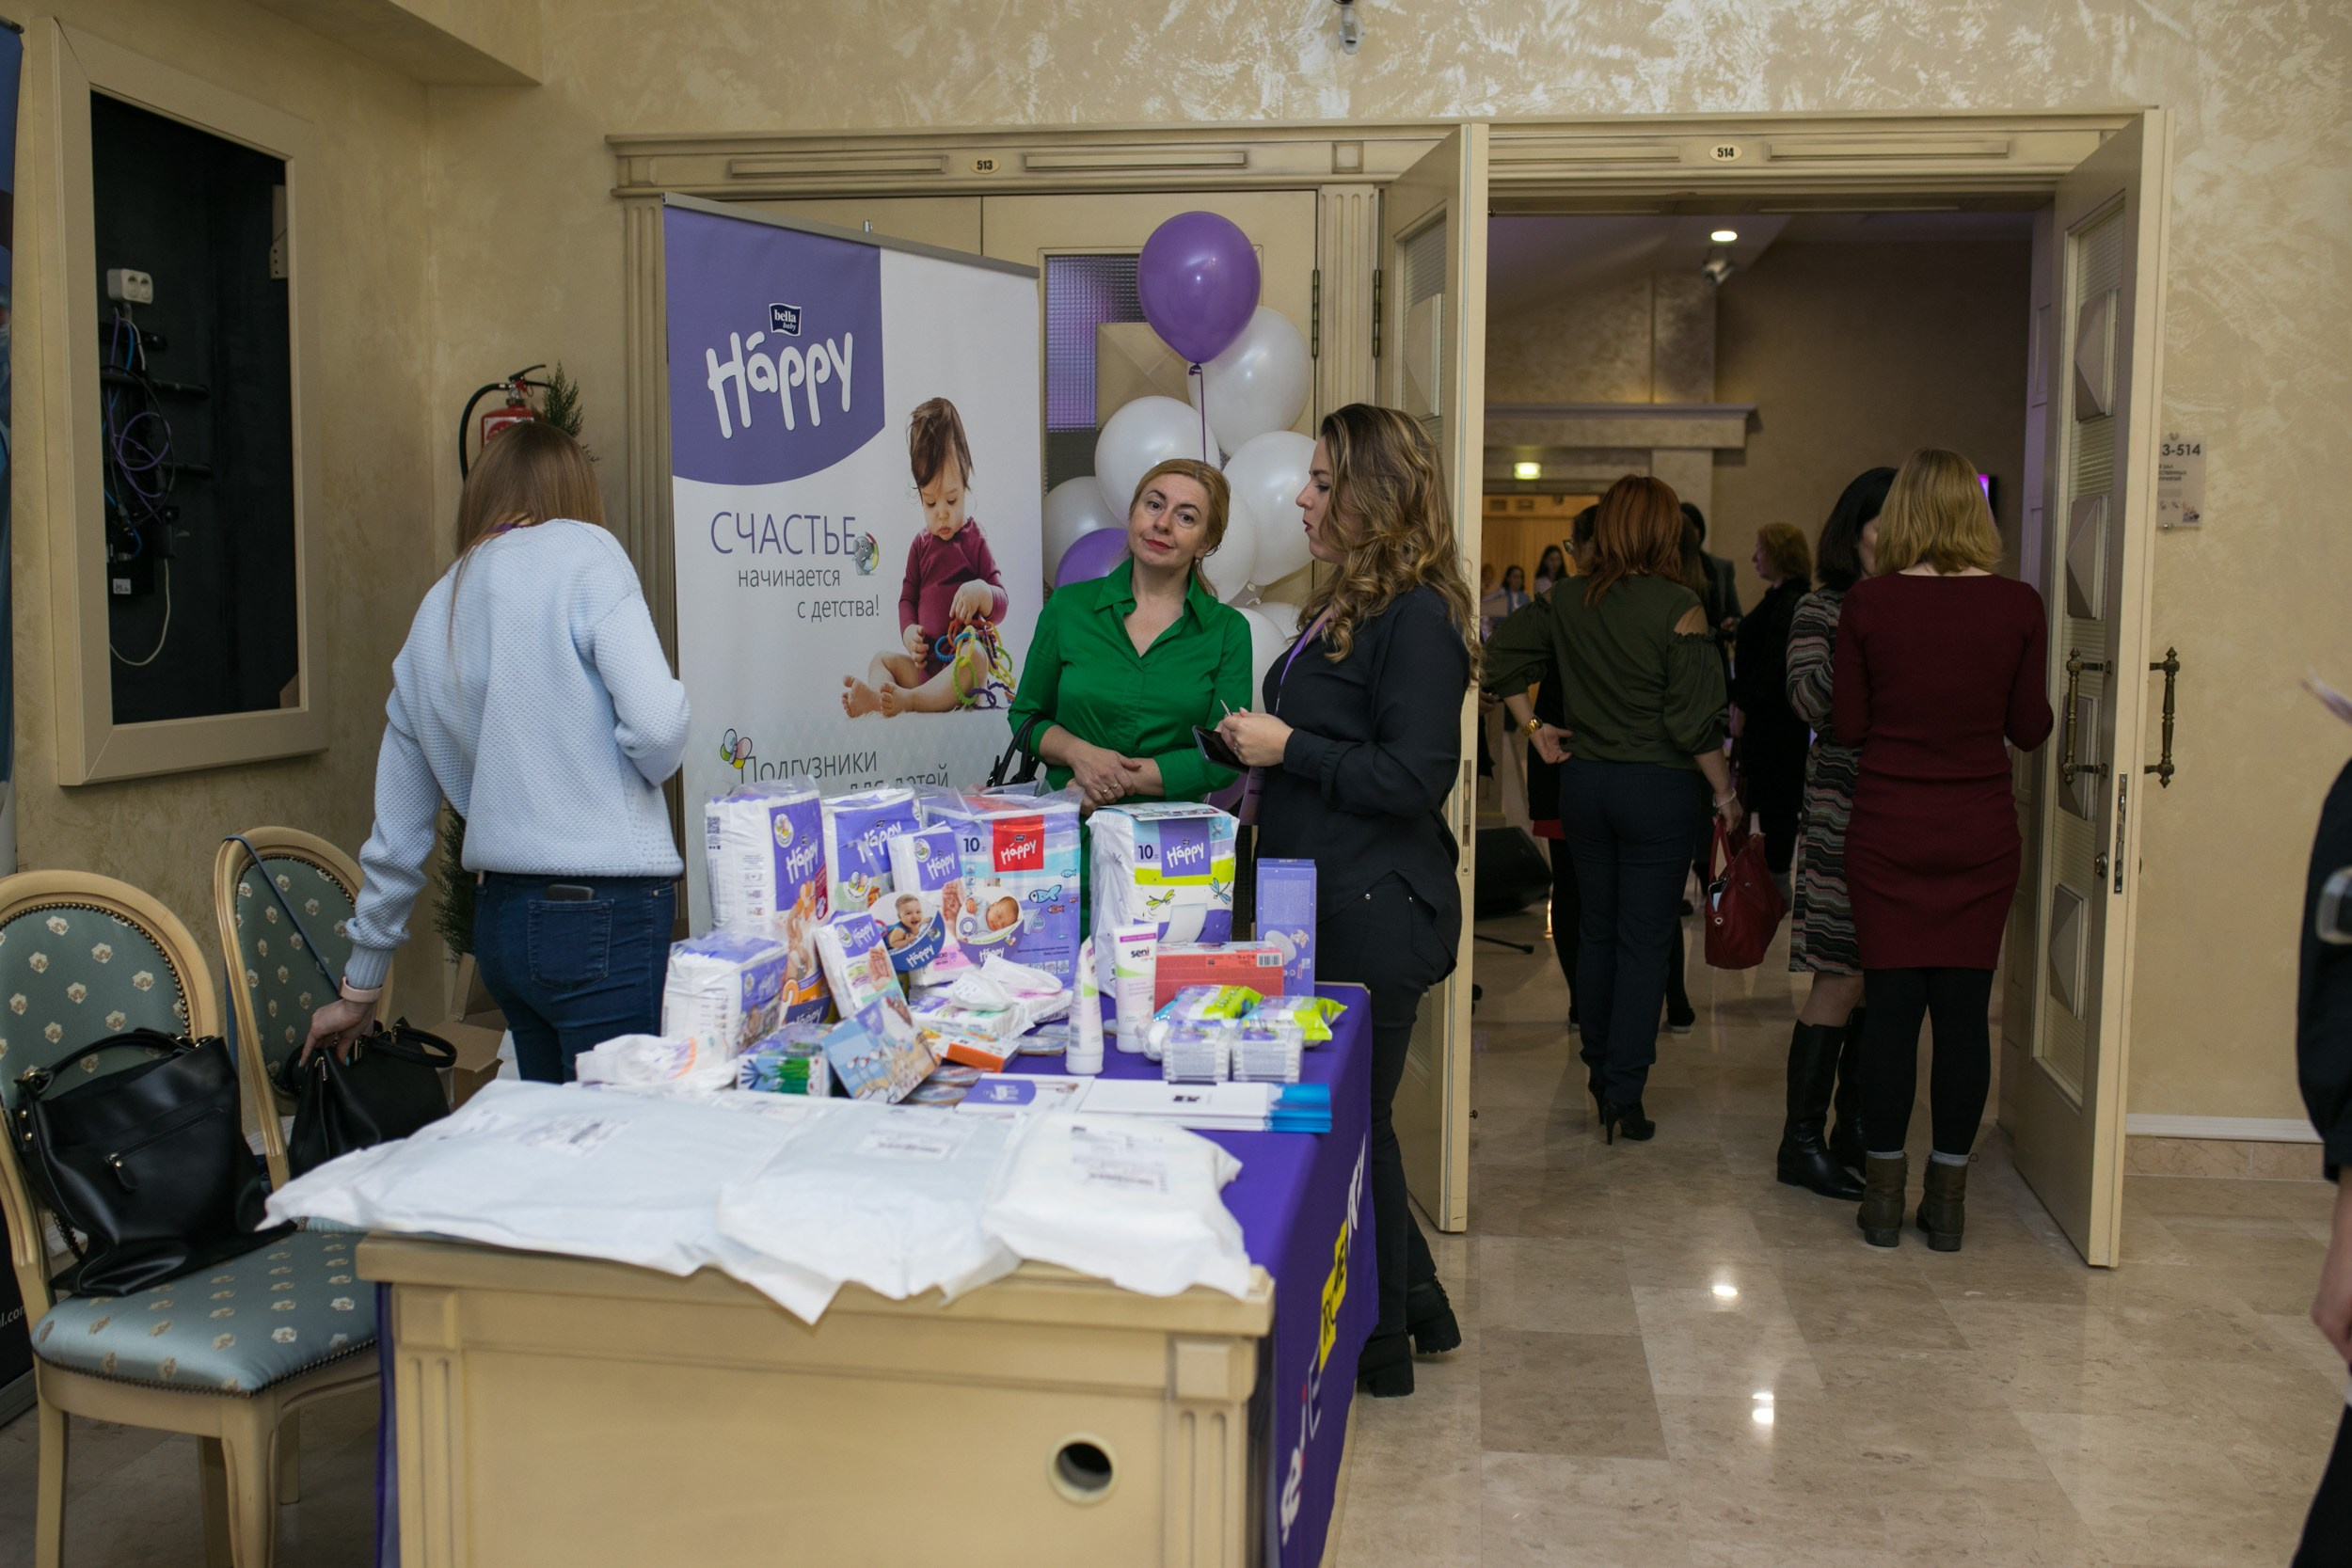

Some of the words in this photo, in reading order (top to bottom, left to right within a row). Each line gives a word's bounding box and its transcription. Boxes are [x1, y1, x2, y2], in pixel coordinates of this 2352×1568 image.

[1717, 147, 1735, 158] 514
[977, 159, 993, 170] 513
[773, 309, 797, 324] bella
[783, 322, 797, 331] baby
[710, 511, 857, 556] СЧАСТЬЕ
[738, 566, 841, 588] начинается
[797, 602, 806, 619] с
[811, 594, 880, 623] детства!
[963, 837, 980, 852] 10
[1138, 844, 1153, 860] 10
[1131, 946, 1150, 958] seni
